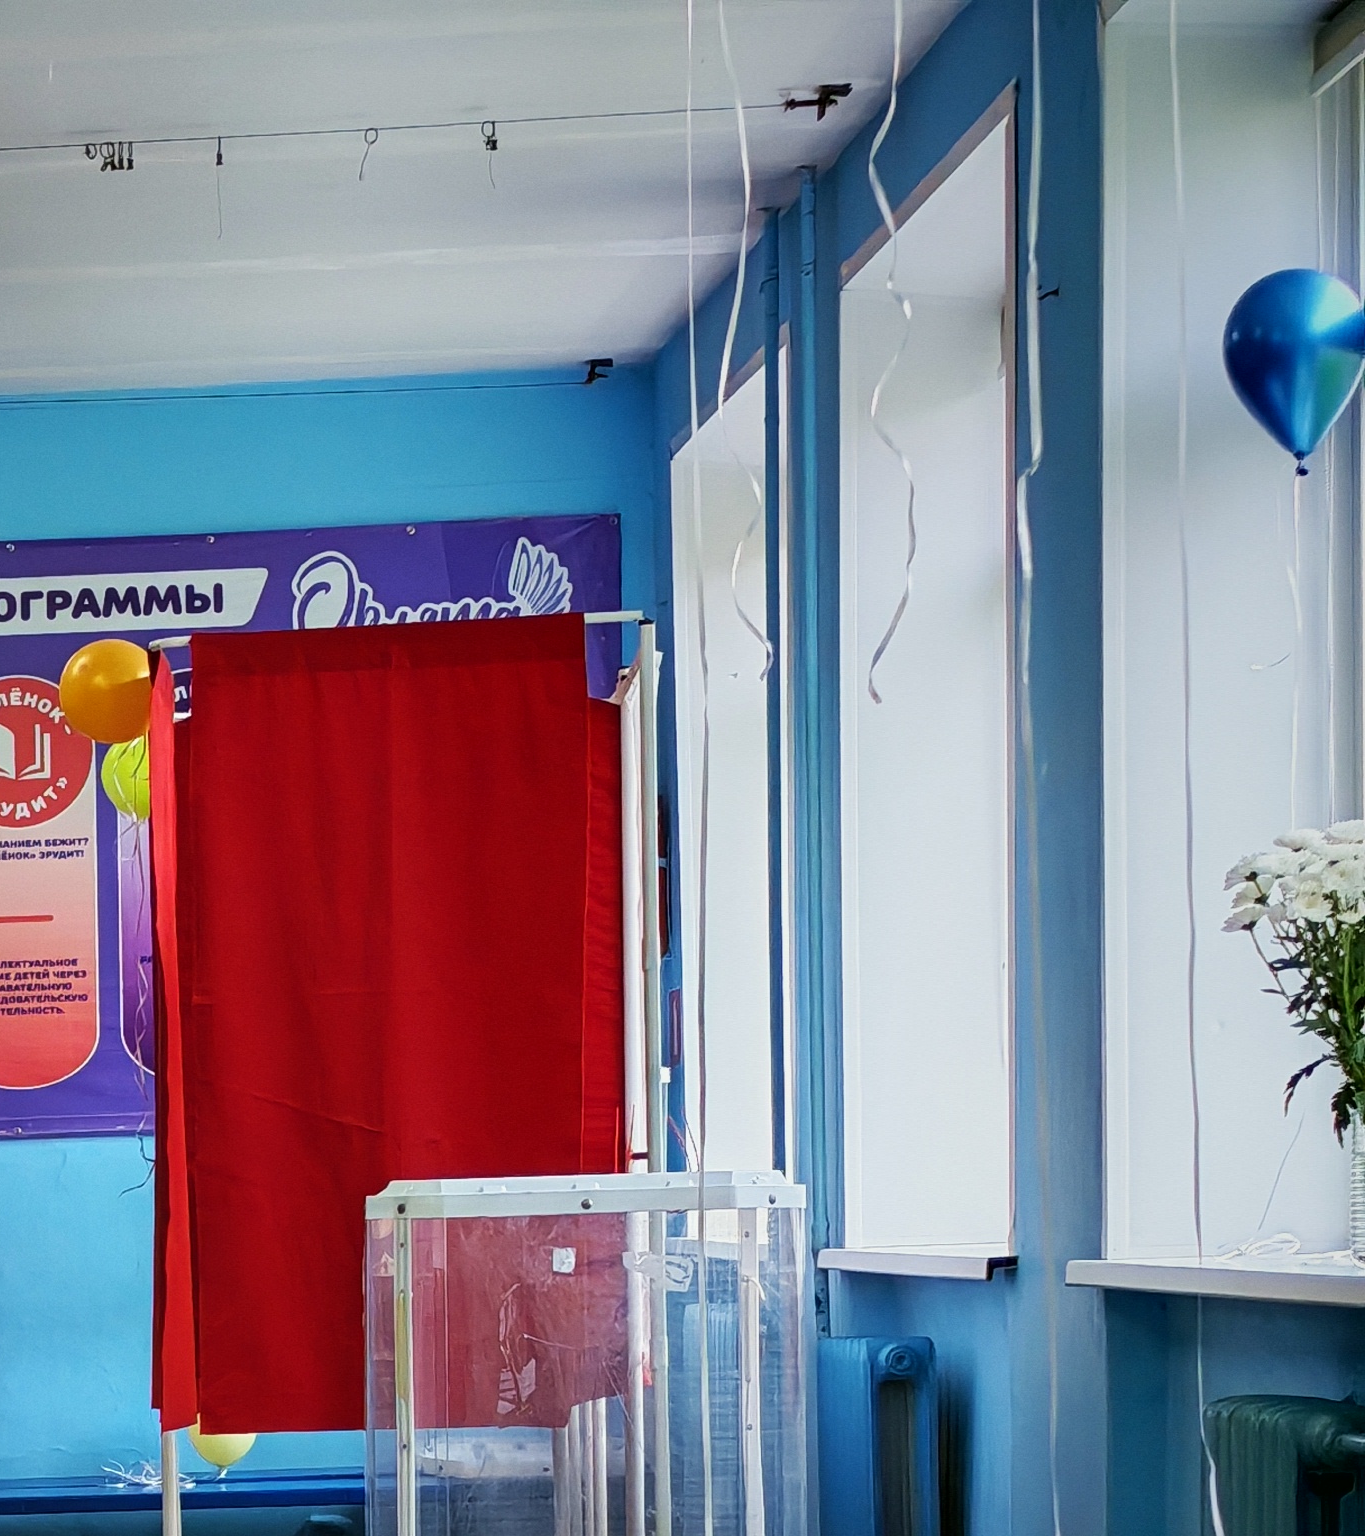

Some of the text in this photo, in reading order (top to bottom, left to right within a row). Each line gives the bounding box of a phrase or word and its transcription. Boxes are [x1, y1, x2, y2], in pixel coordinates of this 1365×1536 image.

[44, 837, 89, 847] БЕЖИТ?
[13, 969, 49, 981] ДЕТЕЙ
[52, 970, 87, 978] ЧЕРЕЗ
